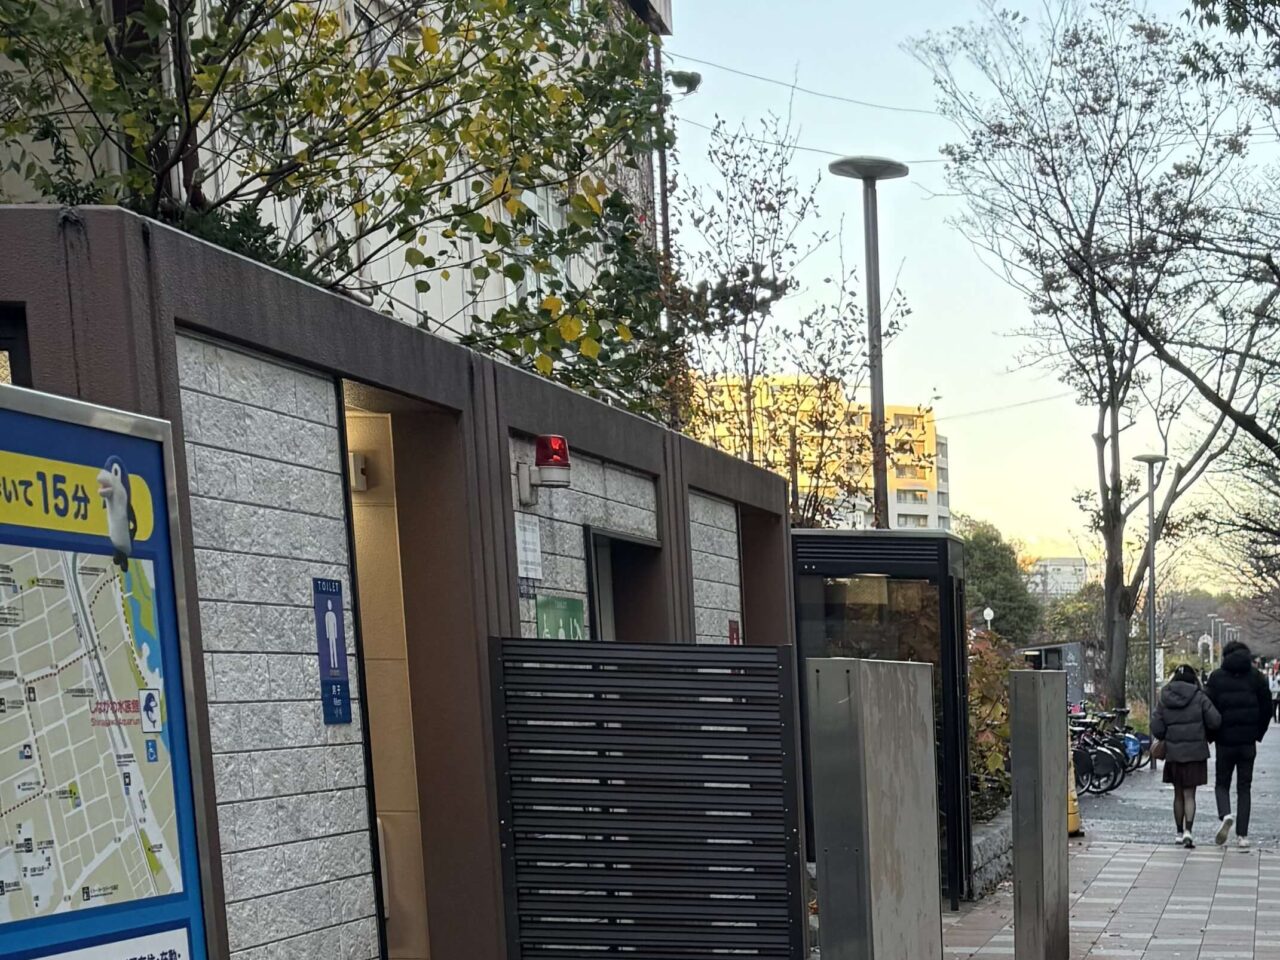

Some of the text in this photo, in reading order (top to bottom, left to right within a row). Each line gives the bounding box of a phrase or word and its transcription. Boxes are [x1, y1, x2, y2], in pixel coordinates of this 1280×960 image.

[0, 470, 90, 520] いて15分
[317, 580, 340, 592] TOILET
